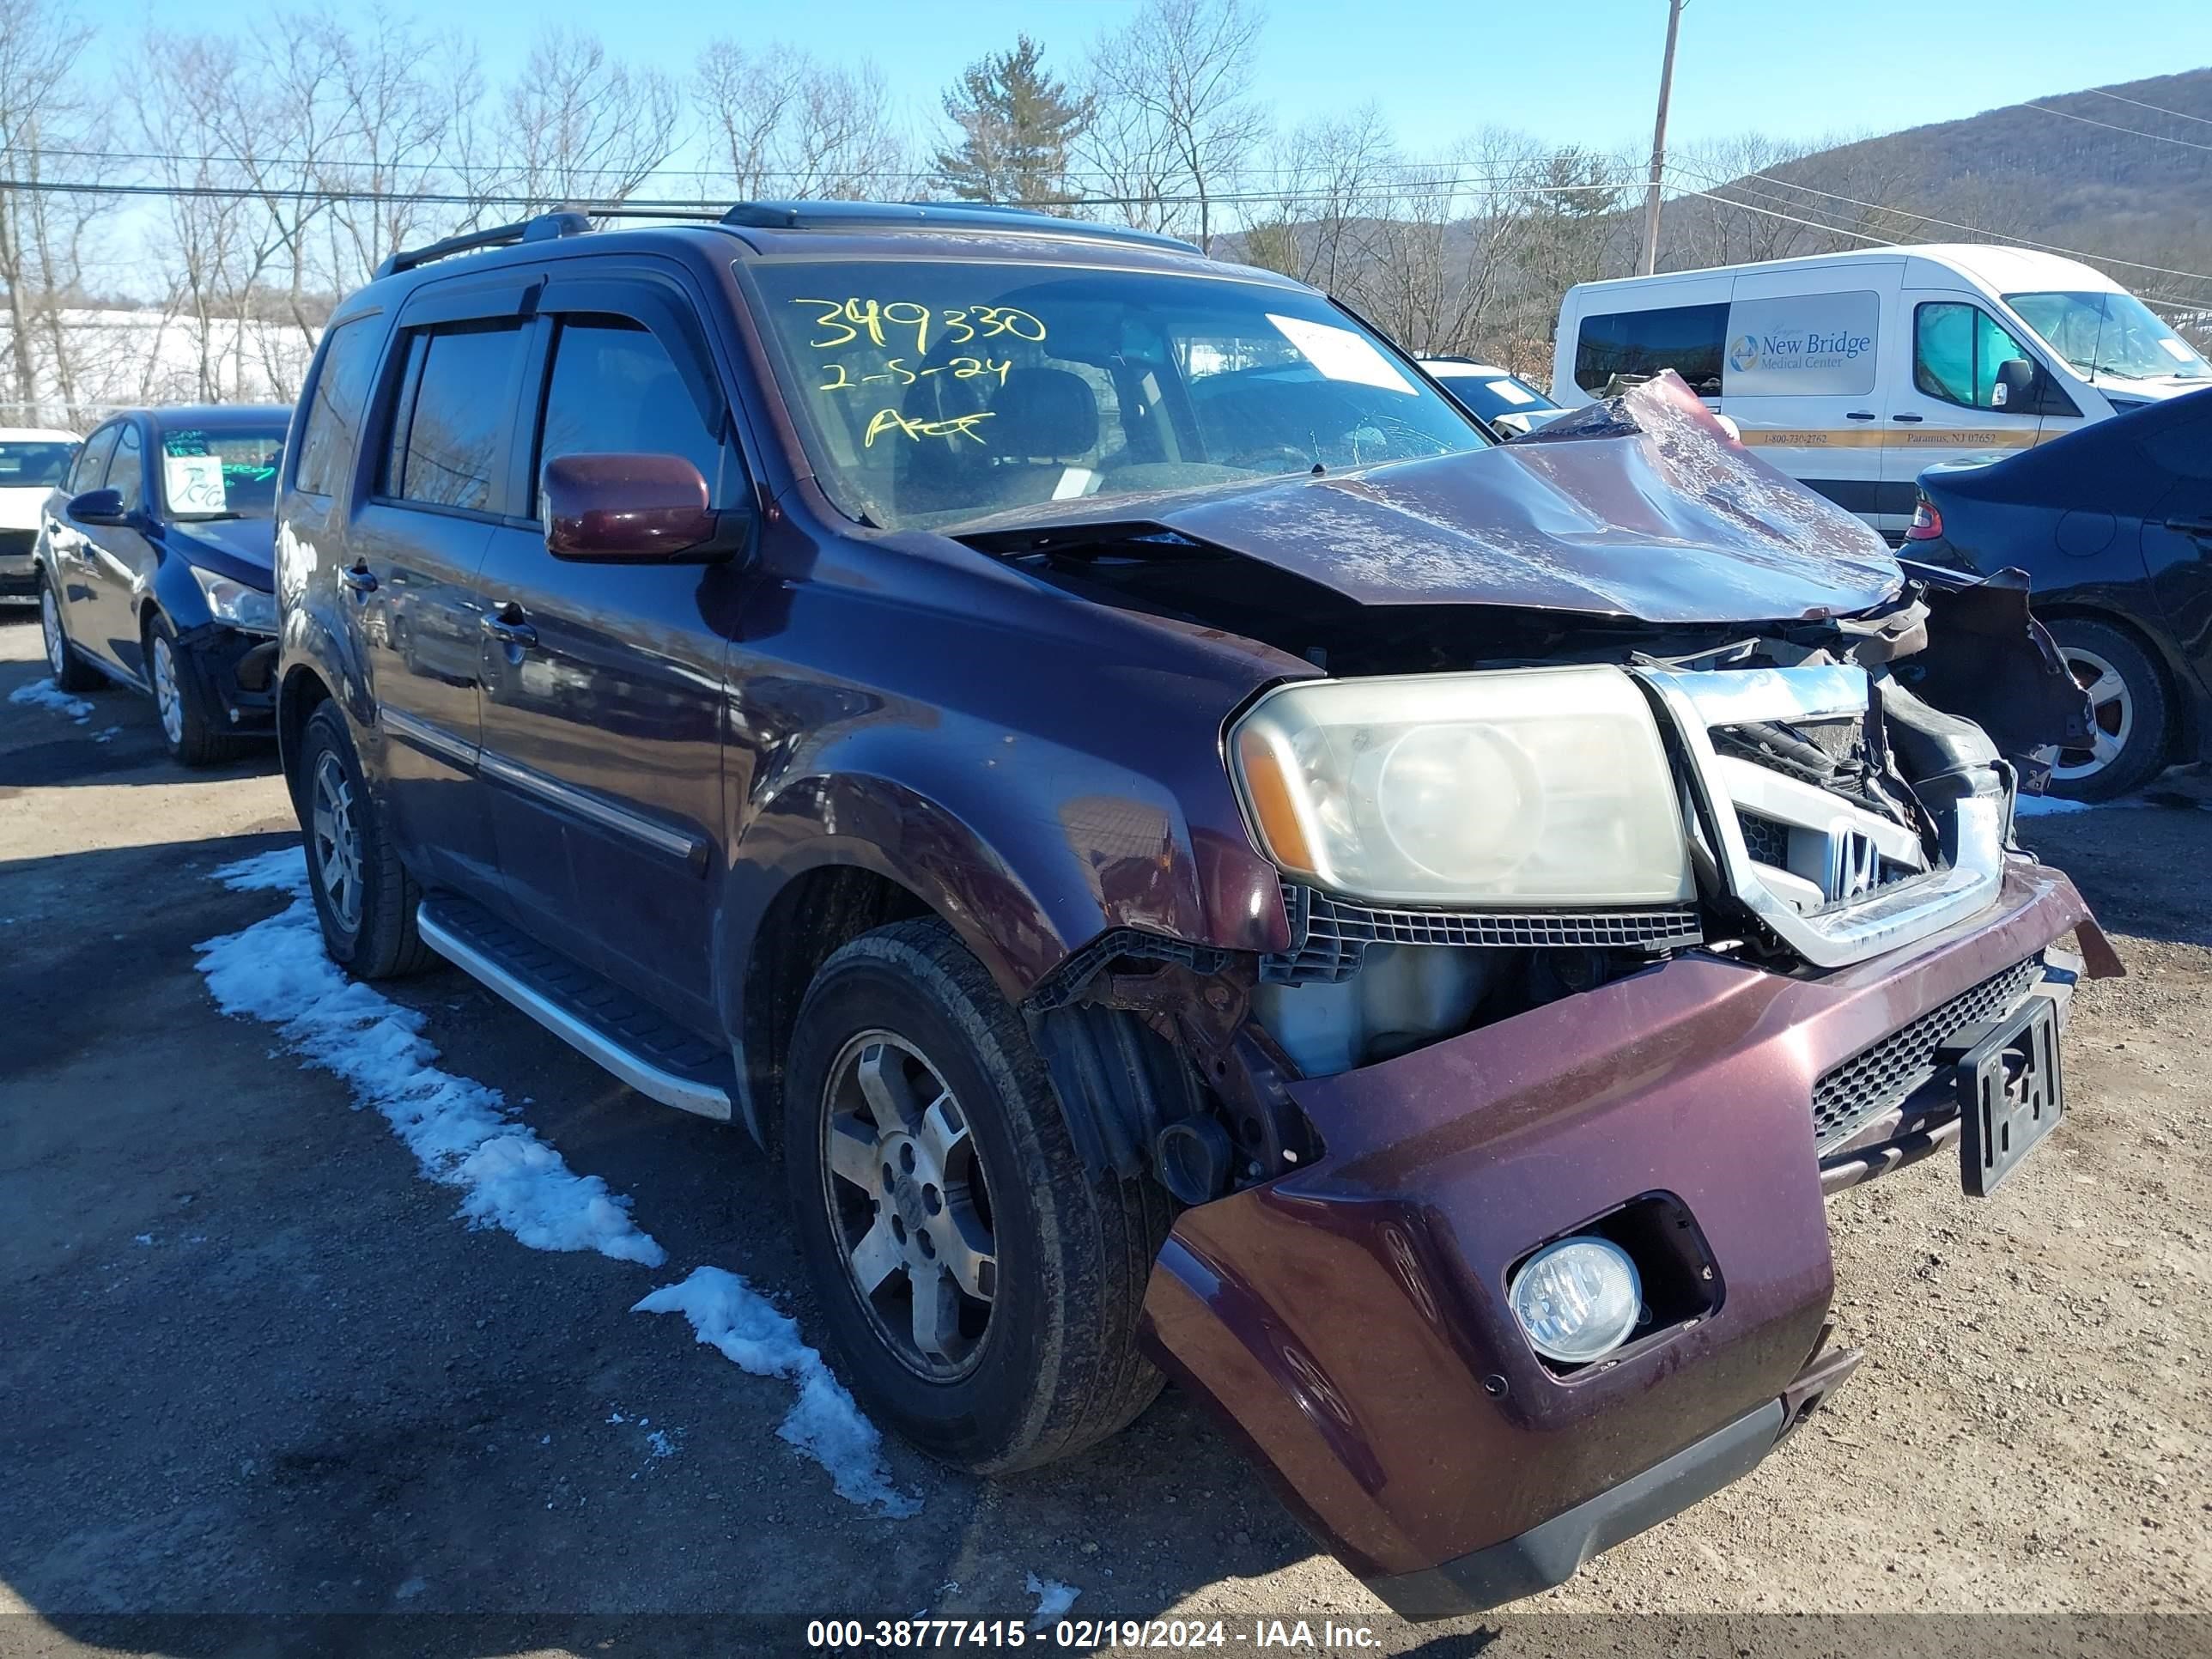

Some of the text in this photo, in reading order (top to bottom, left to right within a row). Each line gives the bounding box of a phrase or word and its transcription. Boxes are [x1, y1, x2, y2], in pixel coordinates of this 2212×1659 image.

[1761, 335, 1803, 356] New
[1806, 330, 1871, 359] Bridge
[1761, 355, 1844, 370] Medical Center
[1906, 433, 1996, 444] Paramus, NJ 07652
